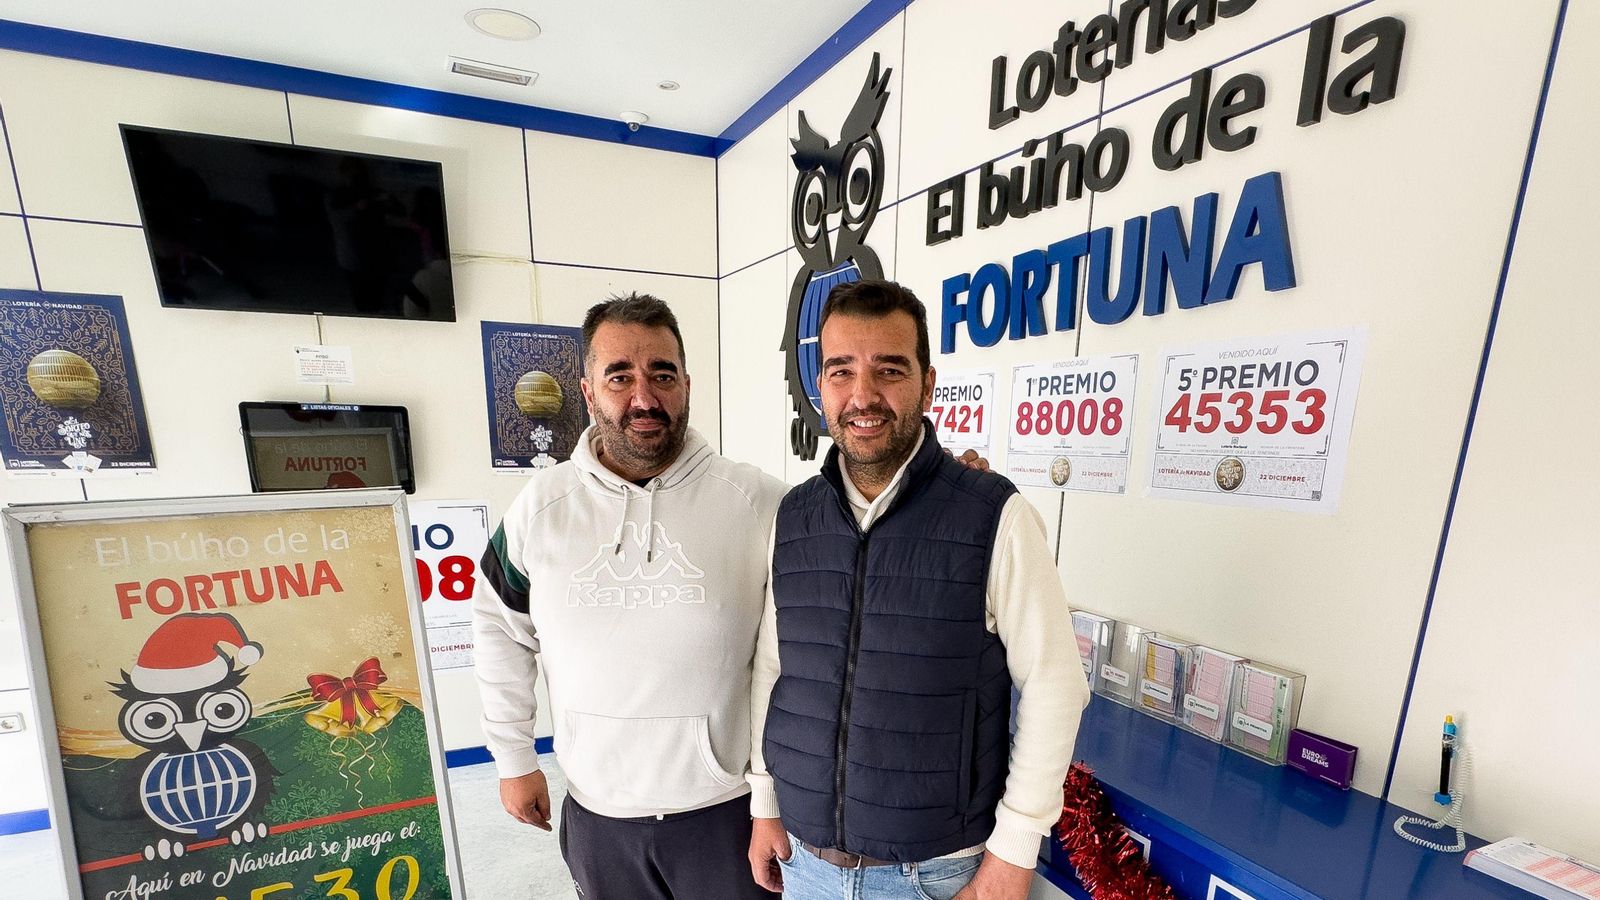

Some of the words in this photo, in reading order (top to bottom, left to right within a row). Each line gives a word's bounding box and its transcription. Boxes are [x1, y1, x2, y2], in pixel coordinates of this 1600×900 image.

[989, 0, 1257, 129] Lotera
[926, 174, 966, 246] El
[976, 127, 1131, 230] búho
[1152, 67, 1266, 171] de
[1296, 14, 1407, 127] la
[940, 171, 1297, 355] FORTUNA
[1218, 348, 1255, 360] VENDIDO
[1038, 370, 1117, 397] PREMIO
[1201, 359, 1320, 391] PREMIO
[934, 384, 983, 403] PREMIO
[932, 404, 984, 434] 7421
[1015, 397, 1124, 436] 88008
[1164, 388, 1328, 435] 45353
[1158, 466, 1180, 474] LOTERÍA
[1185, 469, 1212, 477] NAVIDAD
[1268, 474, 1307, 483] DICIEMBRE
[94, 535, 132, 568] El
[145, 531, 250, 563] búho
[264, 526, 309, 556] de
[319, 523, 351, 551] la
[114, 559, 345, 620] FORTUNA
[567, 582, 707, 610] Kappa
[1301, 752, 1329, 768] DREAMS
[1302, 747, 1321, 759] EURO
[105, 869, 175, 900] Aquí
[180, 870, 207, 889] en
[212, 847, 314, 889] Navidad
[314, 839, 341, 858] se
[340, 829, 396, 864] juega
